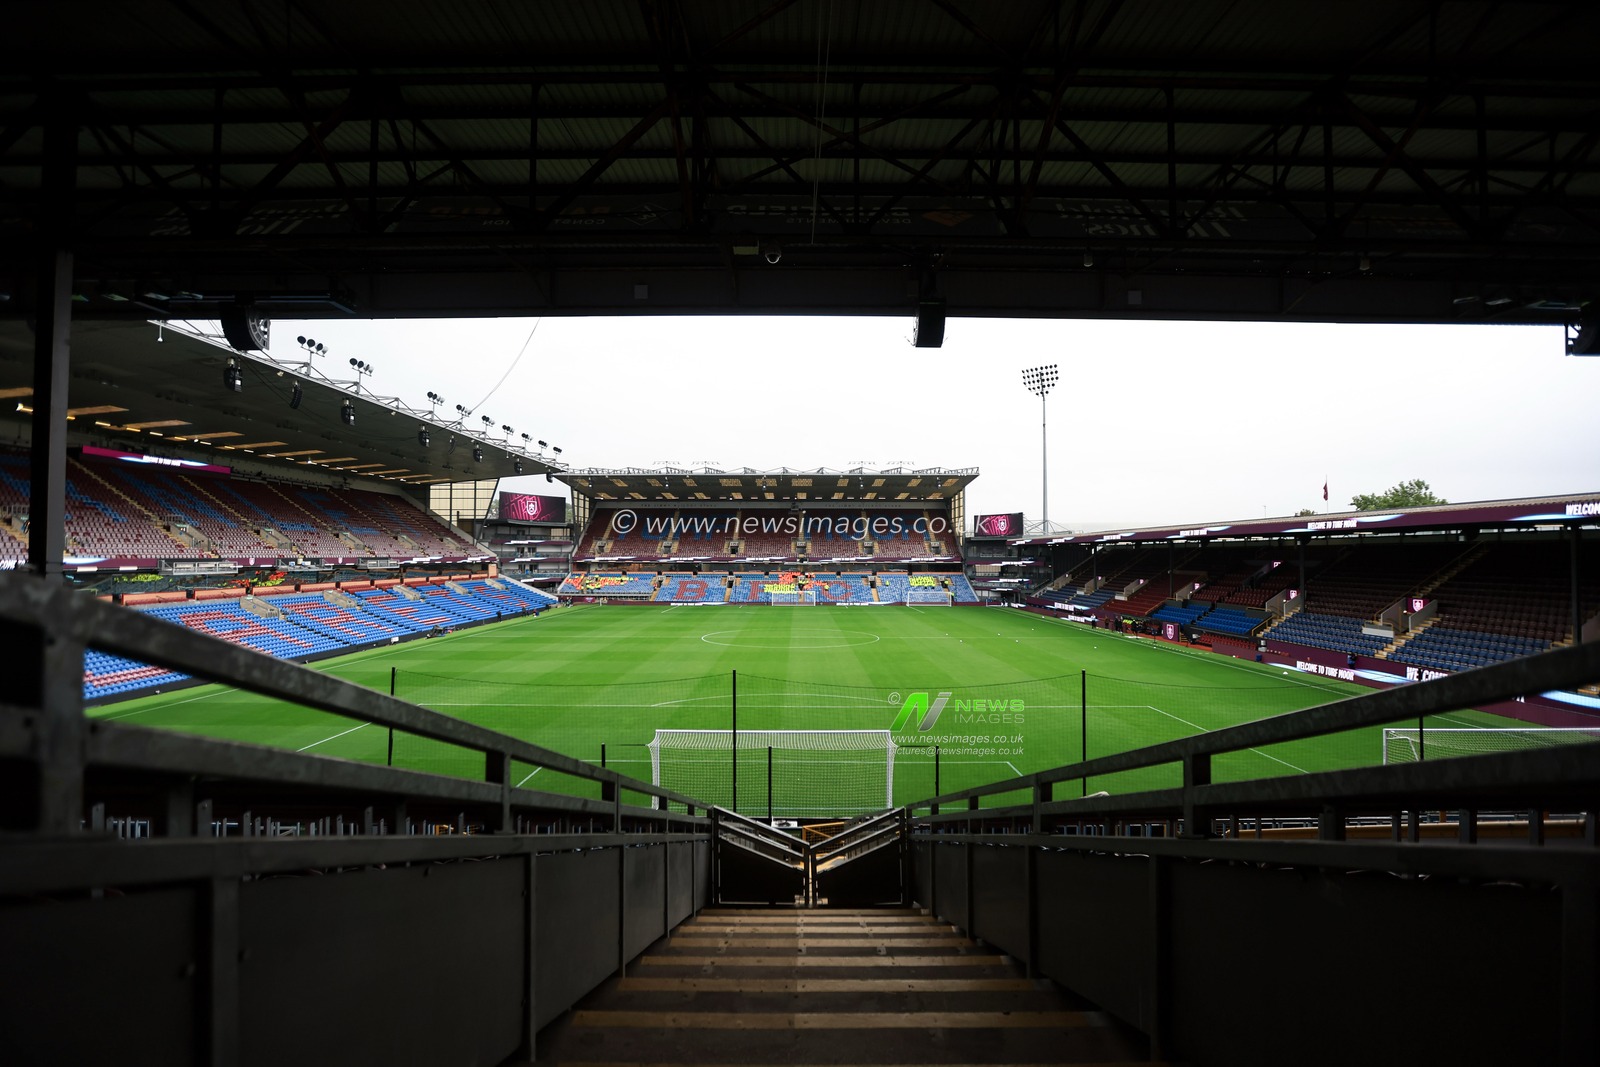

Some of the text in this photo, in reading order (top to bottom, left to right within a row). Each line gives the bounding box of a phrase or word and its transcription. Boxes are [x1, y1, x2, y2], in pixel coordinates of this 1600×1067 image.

[1296, 660, 1355, 681] WELCOME TO TURF MOOR
